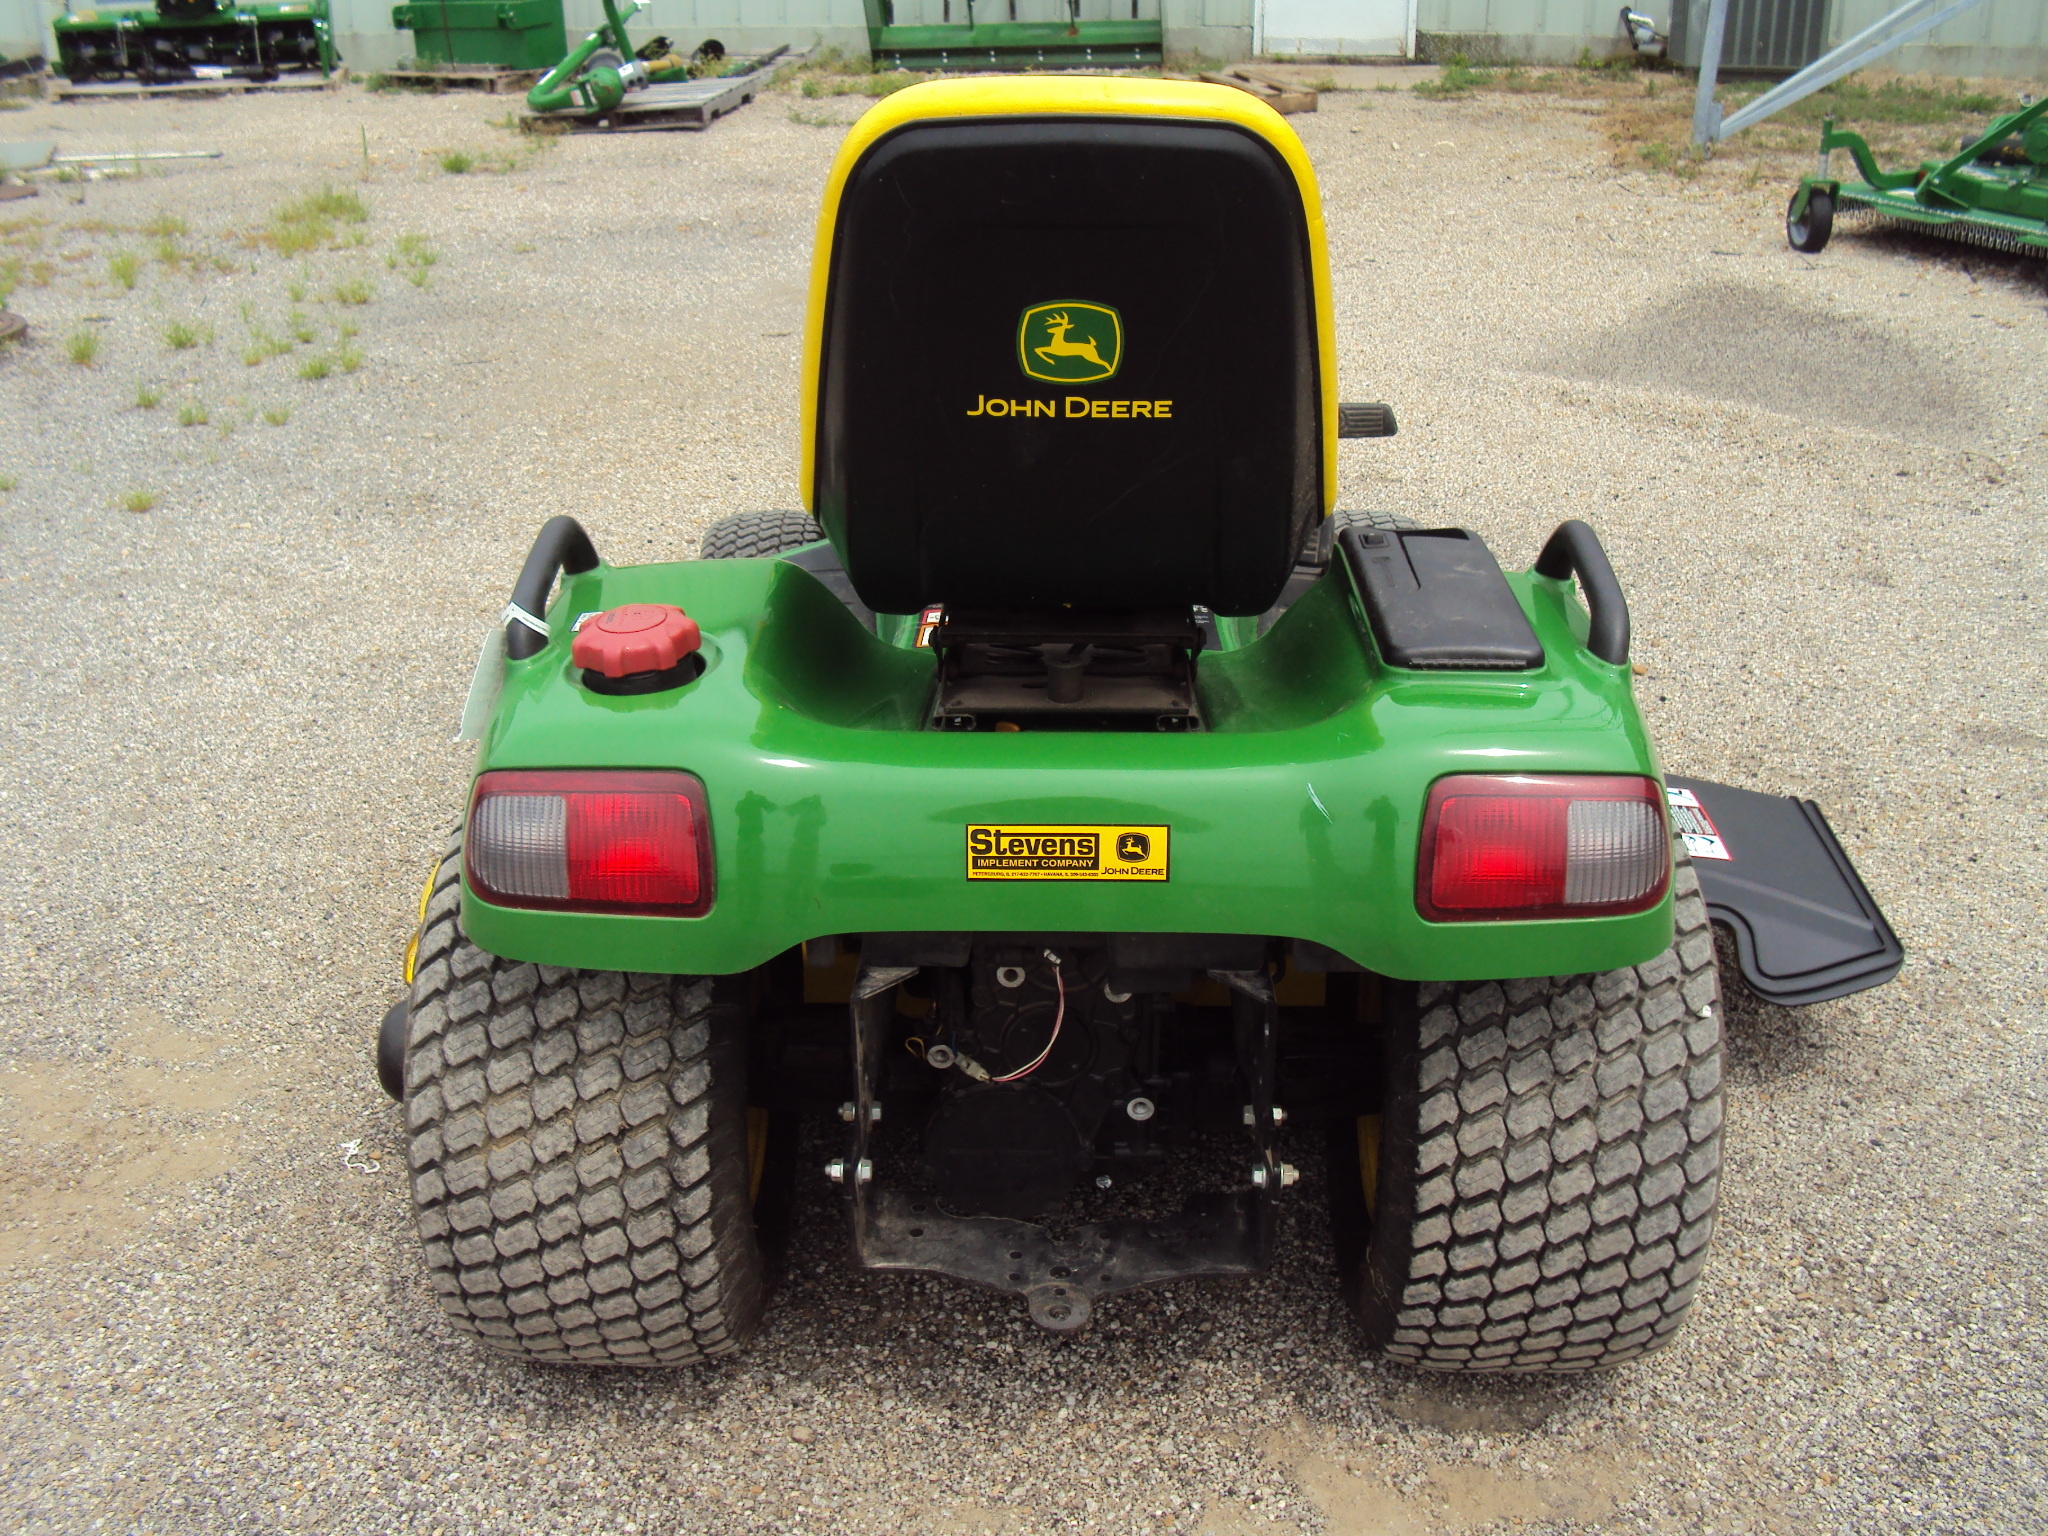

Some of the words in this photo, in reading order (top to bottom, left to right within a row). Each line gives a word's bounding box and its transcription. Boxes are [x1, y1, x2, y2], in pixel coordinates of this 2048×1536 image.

[966, 394, 1056, 418] JOHN
[1065, 396, 1173, 418] DEERE
[970, 828, 1094, 856] Stevens
[977, 859, 1039, 867] IMPLEMENT
[1041, 859, 1094, 868] COMPANY
[1101, 866, 1129, 875] JOHN
[1130, 866, 1165, 876] DEERE
